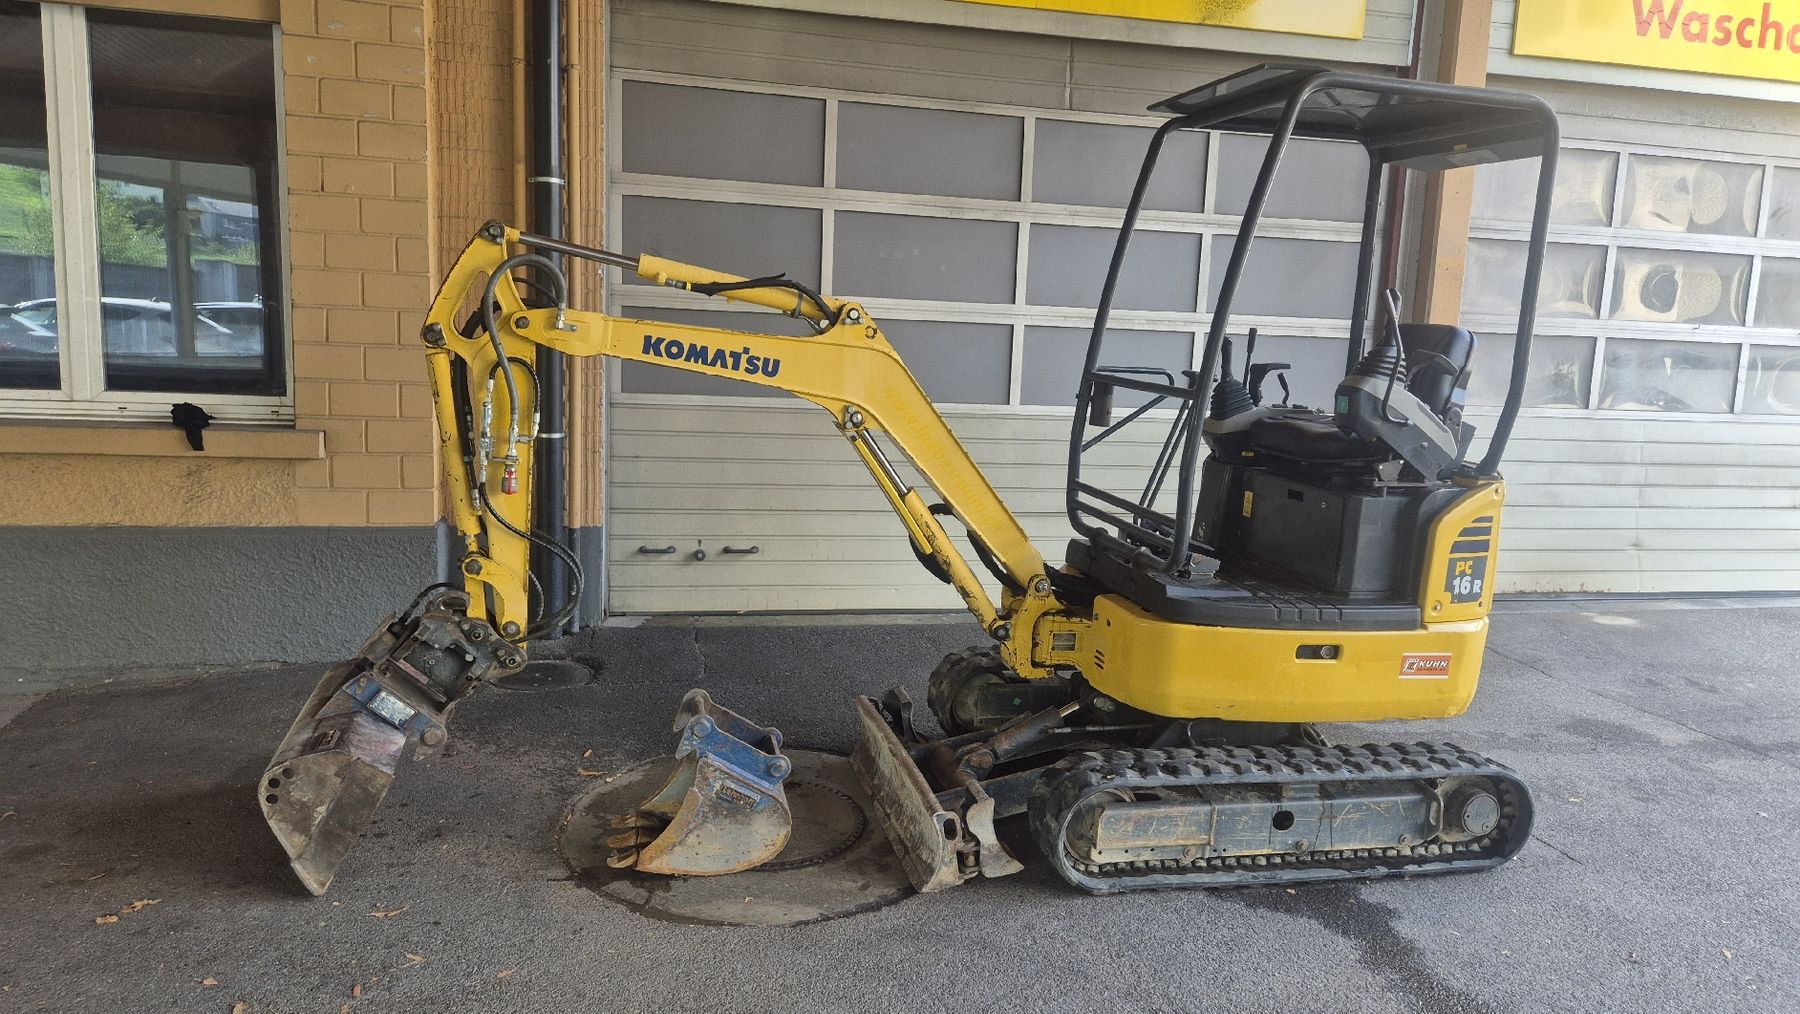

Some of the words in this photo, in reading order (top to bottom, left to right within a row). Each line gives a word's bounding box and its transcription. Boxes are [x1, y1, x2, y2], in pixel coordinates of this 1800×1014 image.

[642, 335, 781, 377] KOMATSU
[1455, 560, 1473, 576] PC
[1419, 660, 1448, 668] KUHN
